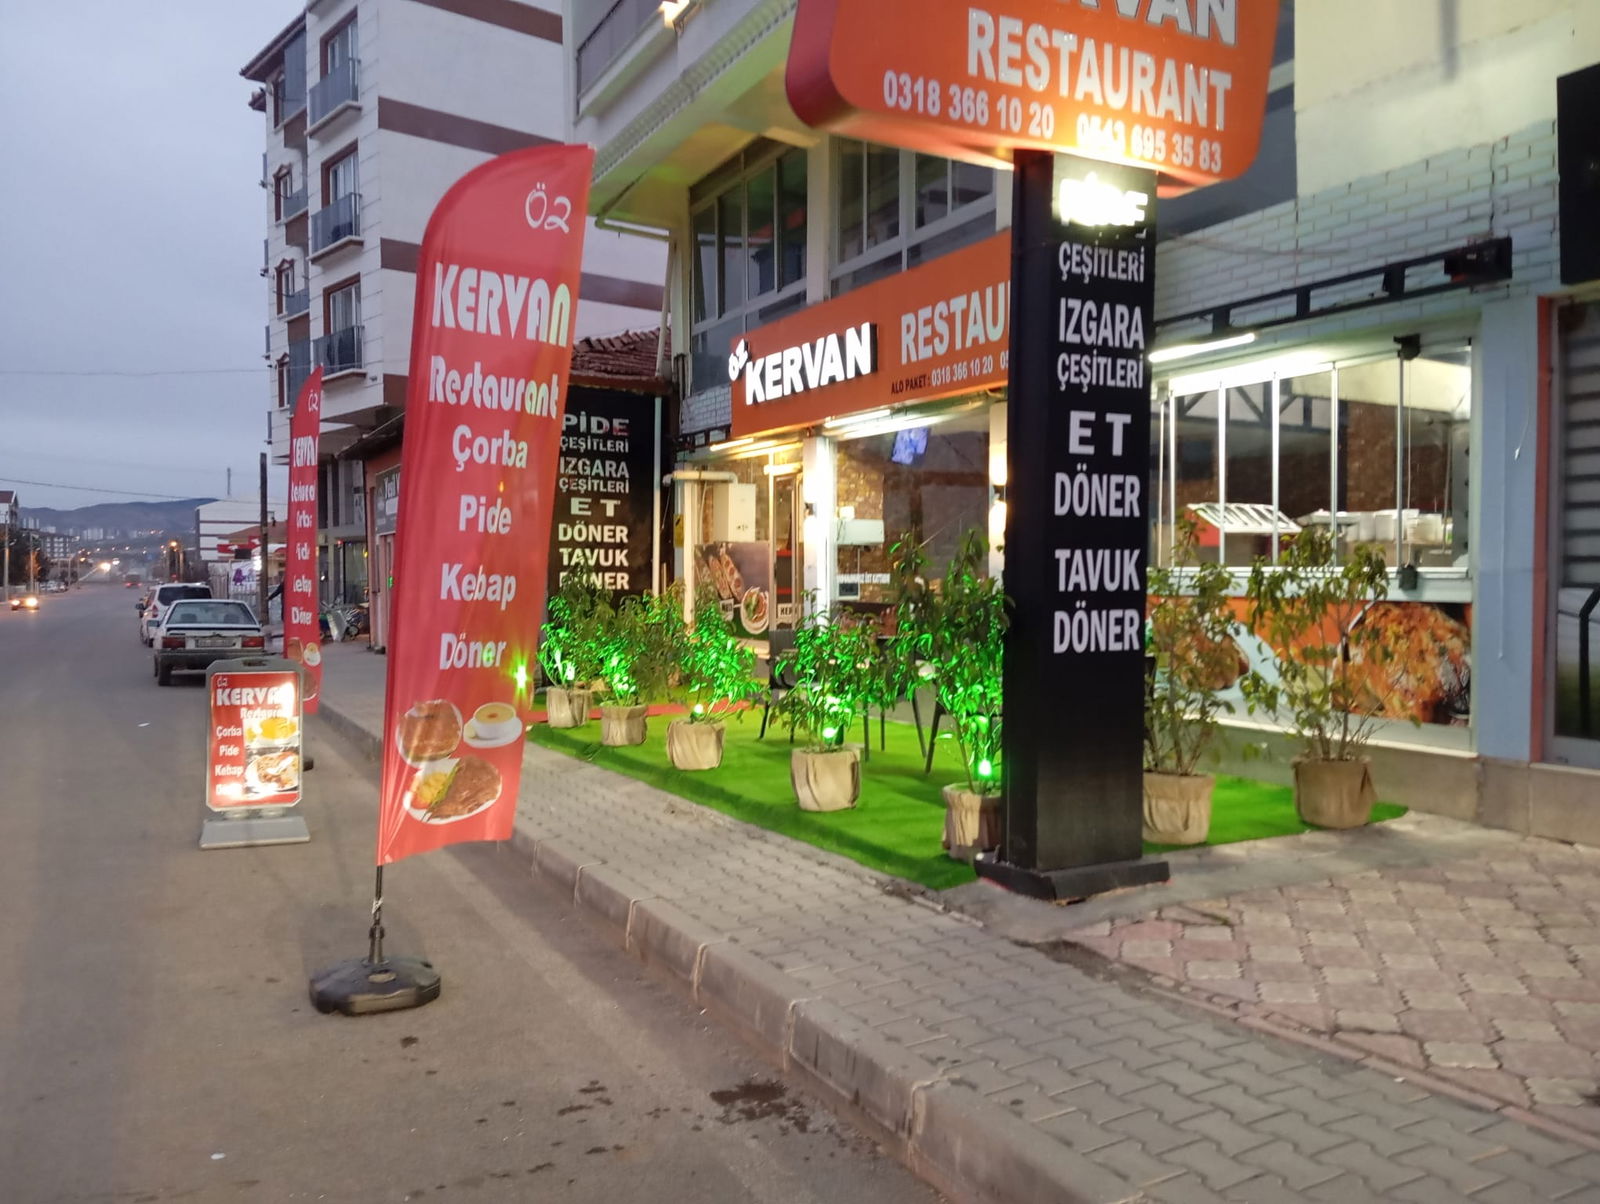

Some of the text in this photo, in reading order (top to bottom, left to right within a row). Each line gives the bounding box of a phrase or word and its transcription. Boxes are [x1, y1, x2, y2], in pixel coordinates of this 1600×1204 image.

[967, 8, 1232, 131] RESTAURANT
[883, 70, 941, 117] 0318
[948, 83, 989, 127] 366
[996, 94, 1023, 134] 10
[1028, 101, 1055, 140] 20
[1130, 124, 1167, 163] 695
[1171, 132, 1195, 168] 35
[1199, 138, 1223, 175] 83
[1058, 240, 1145, 284] ÇEŞİTLERİ
[432, 262, 570, 347] KERVAN
[901, 280, 1011, 366] RESTAU
[1059, 297, 1145, 350] IZGARA
[745, 322, 871, 406] KERVAN
[931, 366, 951, 387] 0318
[952, 361, 968, 382] 366
[970, 358, 981, 377] 10
[982, 354, 993, 375] 20
[1057, 350, 1144, 393] ÇEŞİTLERİ
[429, 355, 559, 419] Restaurant
[562, 411, 629, 436] PİDE
[453, 425, 528, 472] Çorba
[560, 457, 630, 479] IZGARA
[559, 476, 630, 494] ÇEŞİTLERİ
[1054, 462, 1141, 518] DÖNER
[459, 495, 512, 534] Pide
[558, 521, 629, 543] DÖNER
[559, 548, 629, 567] TAVUK
[1054, 549, 1141, 592] TAVUK
[440, 563, 516, 611] Kebap
[1053, 600, 1141, 654] DÖNER
[439, 632, 506, 670] Döner
[216, 687, 294, 706] KERVA
[215, 764, 243, 777] Kebap
[219, 744, 240, 757] Pide
